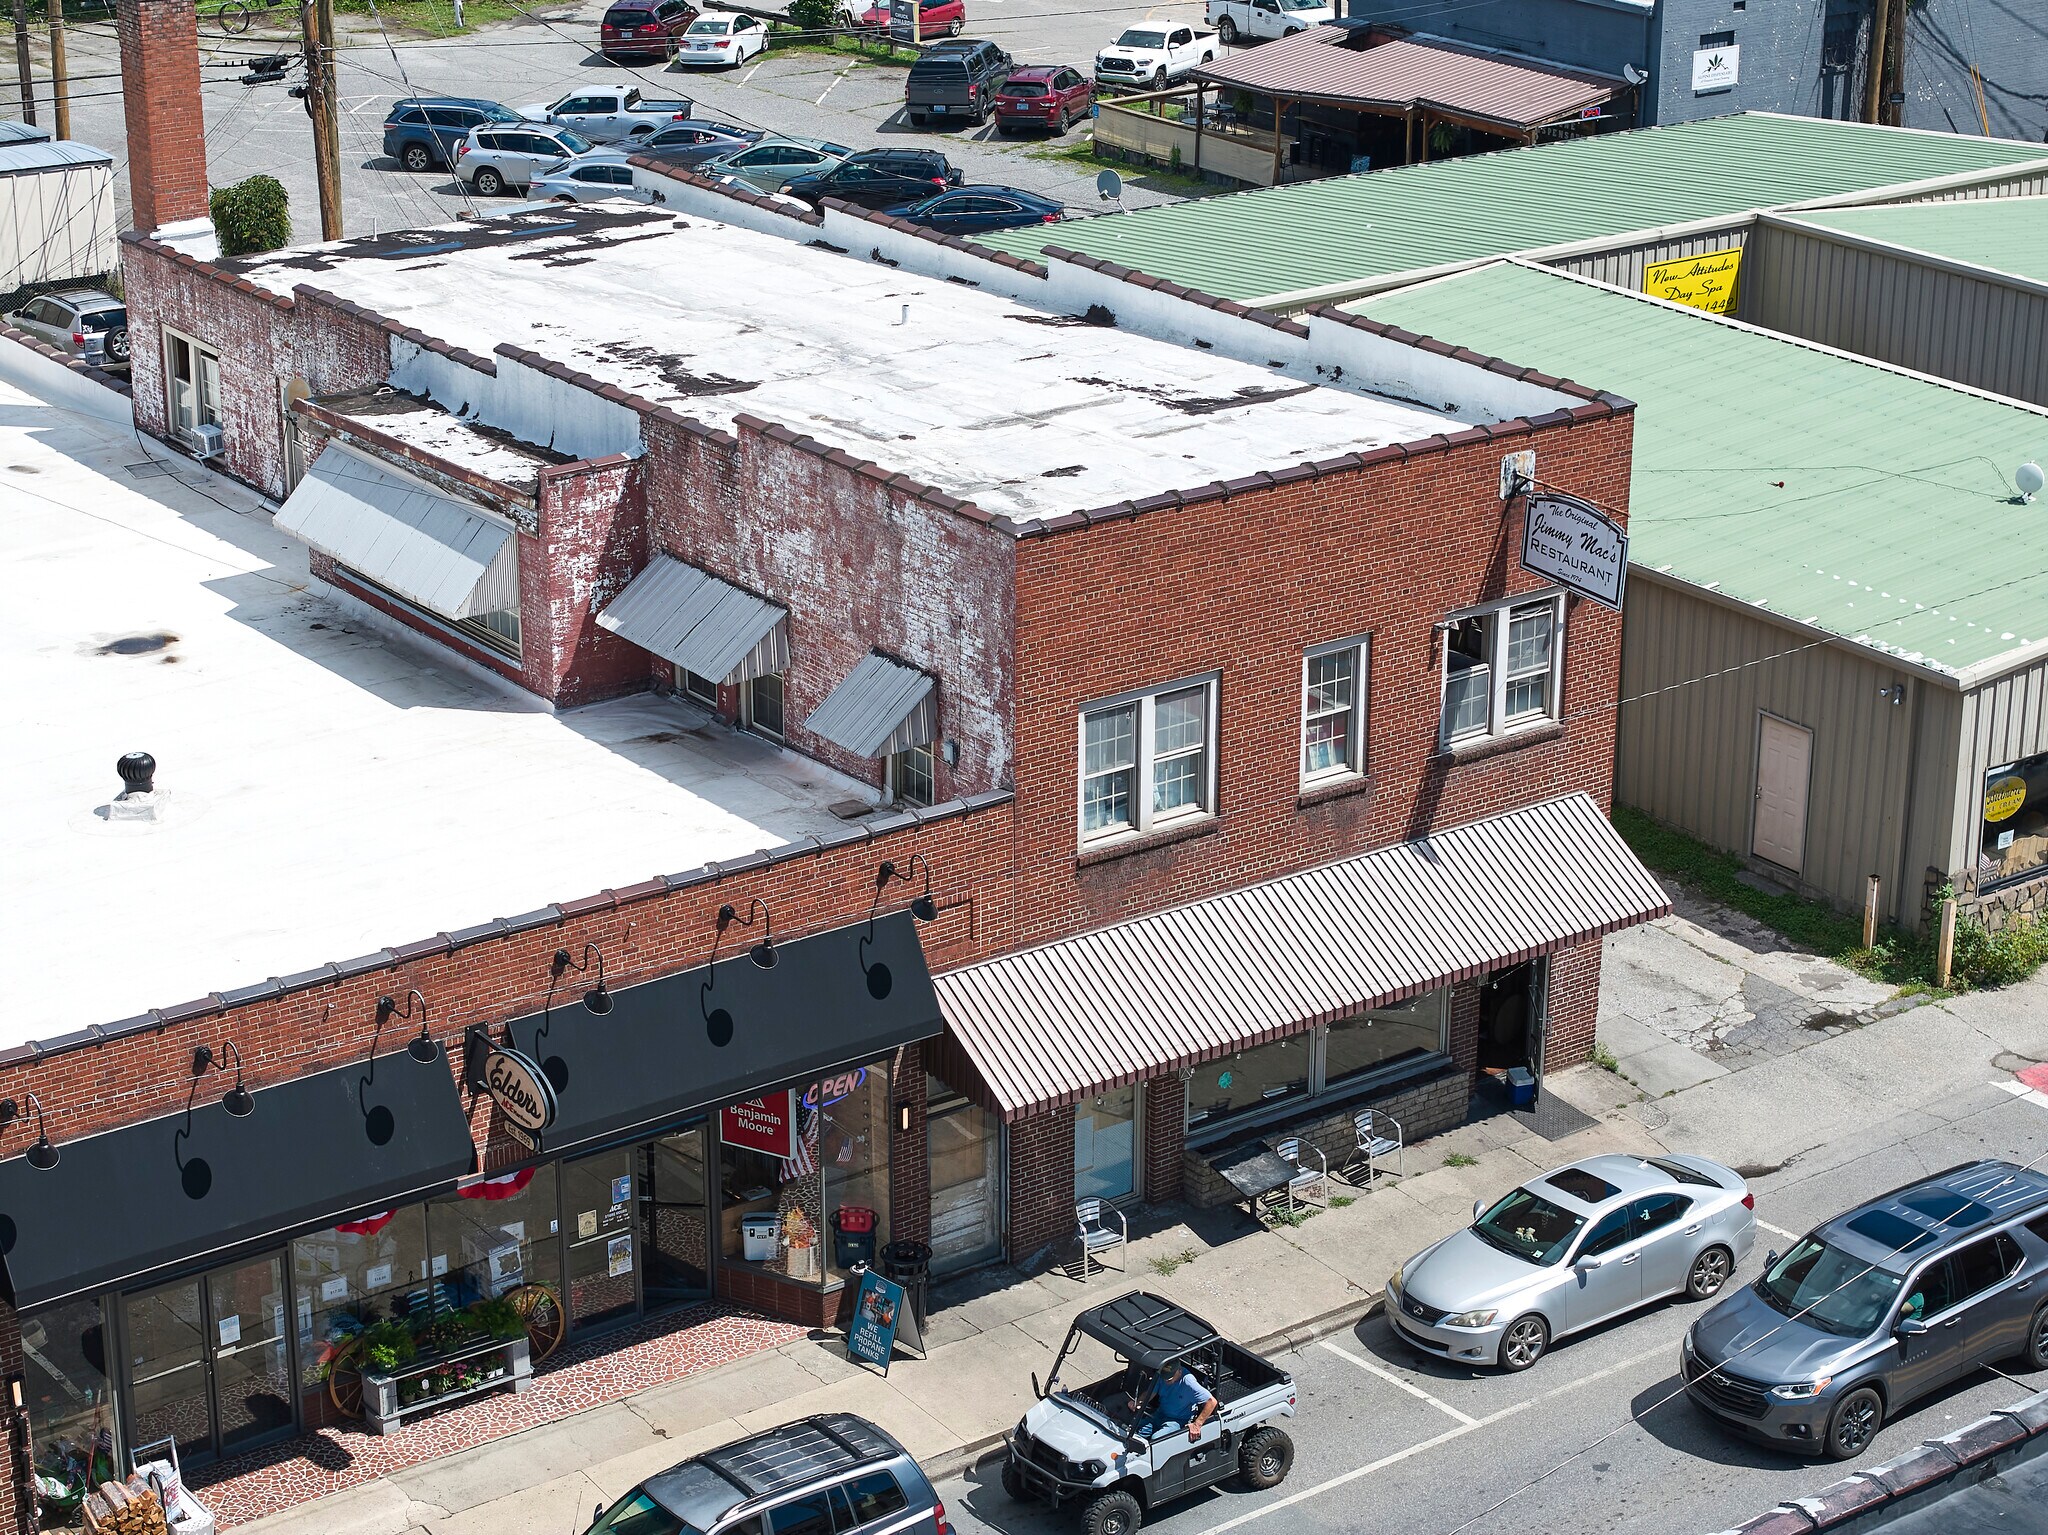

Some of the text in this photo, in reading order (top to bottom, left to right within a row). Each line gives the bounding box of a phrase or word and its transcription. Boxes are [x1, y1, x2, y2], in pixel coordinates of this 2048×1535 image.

[1584, 108, 1599, 118] OPEN
[1653, 258, 1734, 284] New Attitudes
[1665, 279, 1723, 301] Day Spa
[1549, 504, 1599, 530] The Original
[1531, 513, 1617, 563] Jimmy Mac's
[1530, 538, 1613, 584] RESTAURANT
[1557, 568, 1570, 579] Since
[807, 1071, 860, 1104] OPEN
[501, 1097, 514, 1113] ACE
[730, 1104, 781, 1126] Benjamin
[738, 1117, 774, 1136] Moore
[609, 1202, 623, 1213] ACE
[859, 1327, 882, 1345] REFILL
[867, 1322, 879, 1334] WE
[854, 1333, 886, 1355] PROPANE
[857, 1343, 880, 1360] TANKS
[1223, 1411, 1247, 1424] Kawasaki
